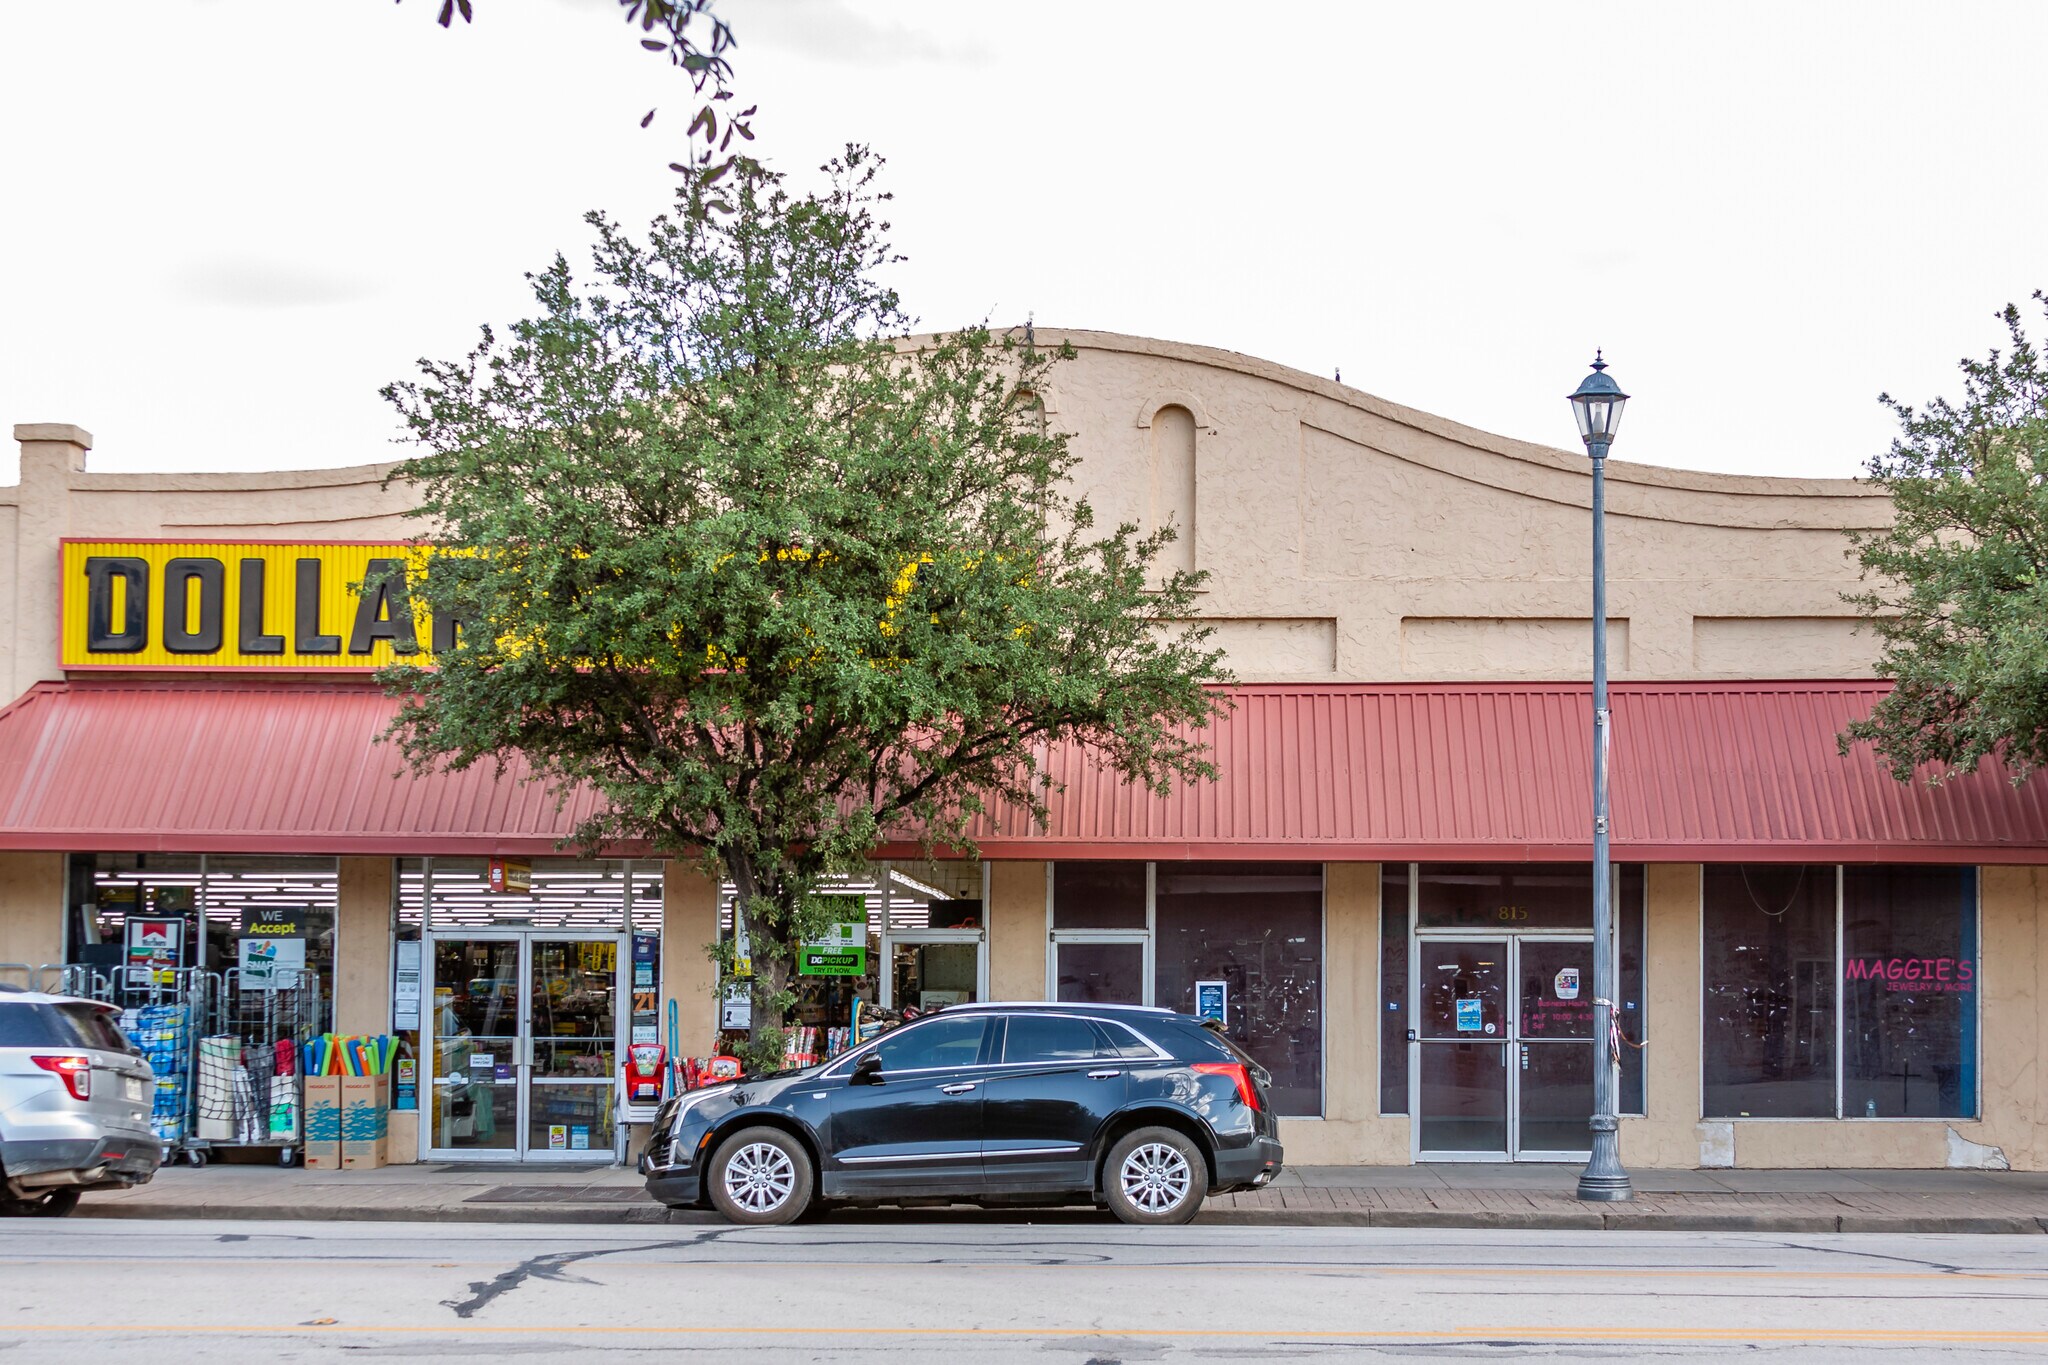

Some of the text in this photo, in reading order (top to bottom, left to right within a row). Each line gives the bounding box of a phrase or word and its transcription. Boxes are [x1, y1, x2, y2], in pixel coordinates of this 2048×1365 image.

[261, 911, 283, 921] WE
[1498, 906, 1528, 920] 815
[249, 922, 296, 935] Accept
[1845, 957, 1974, 981] MAGGIE'S
[1886, 982, 1973, 992] JEWELRY & MORE
[634, 992, 656, 1011] 21
